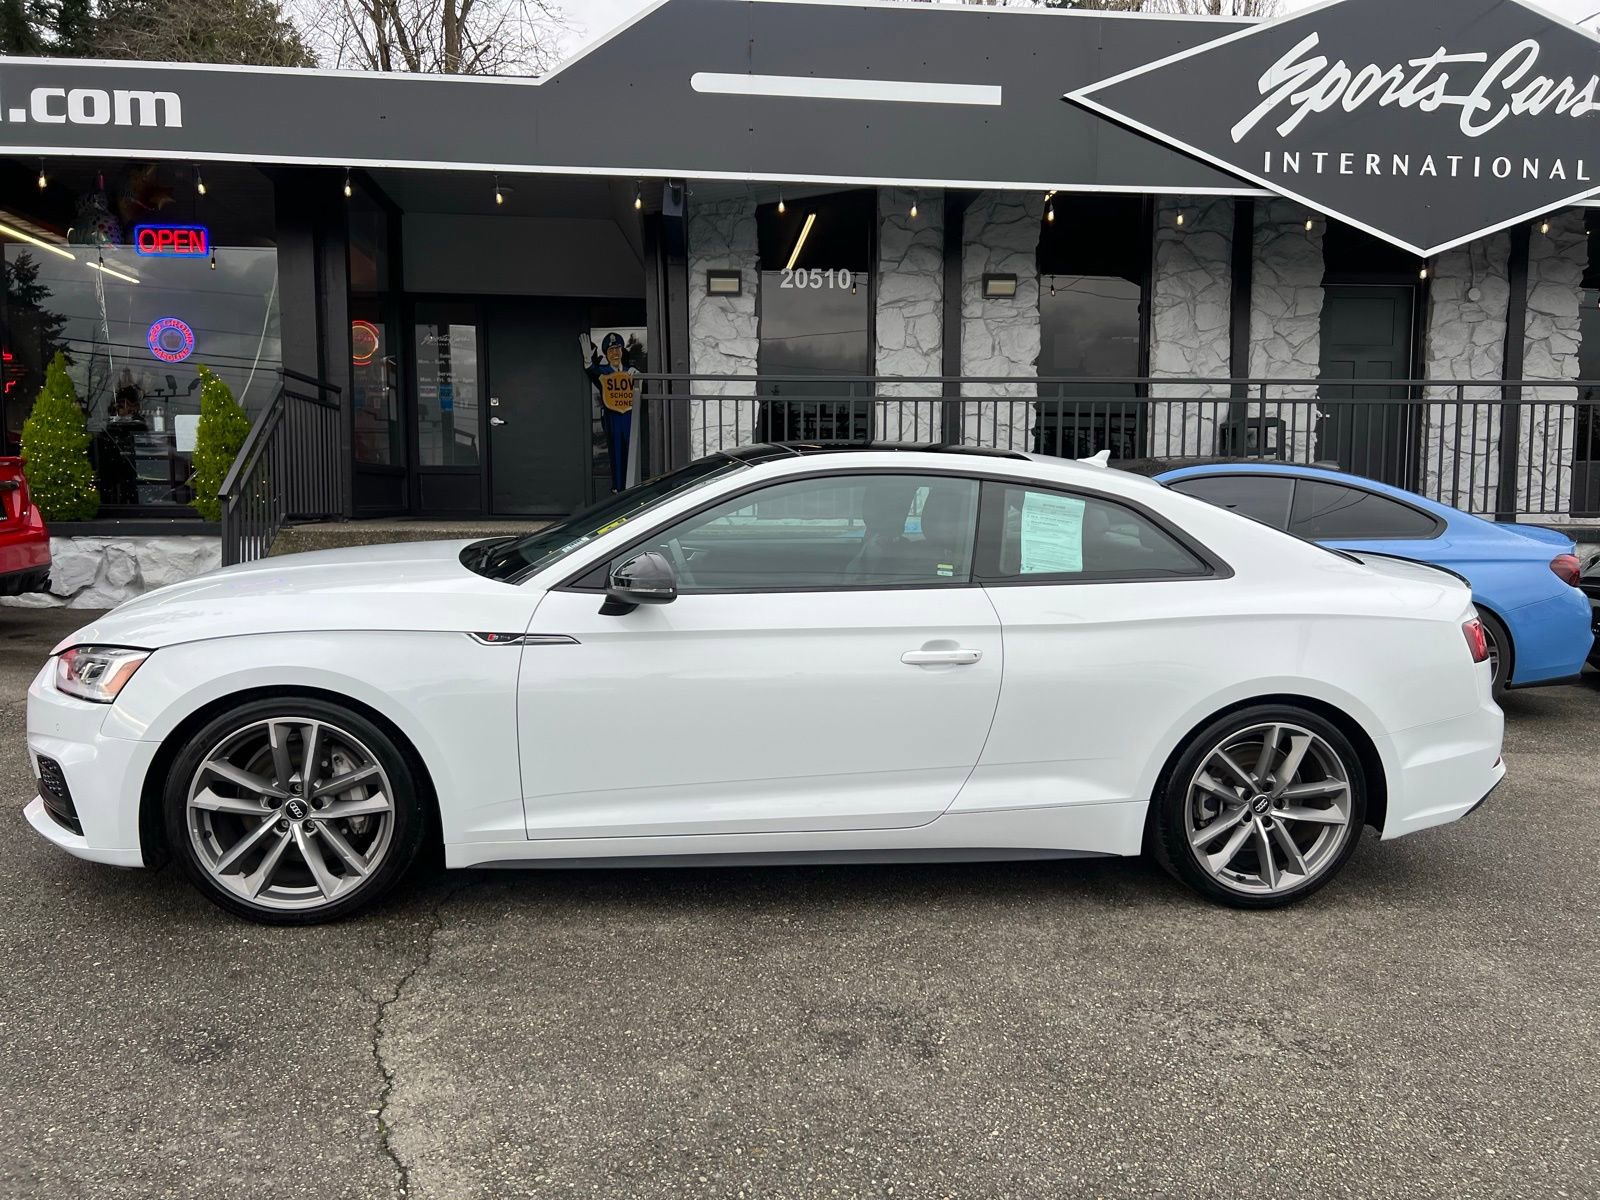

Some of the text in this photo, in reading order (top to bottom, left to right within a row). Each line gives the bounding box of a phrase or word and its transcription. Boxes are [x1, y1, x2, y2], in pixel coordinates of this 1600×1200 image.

[1231, 32, 1600, 142] Sports Cars
[0, 87, 182, 128] .com
[1263, 151, 1591, 181] INTERNATIONAL
[138, 229, 207, 254] OPEN
[780, 267, 851, 289] 20510
[150, 319, 193, 345] RED CROWN
[153, 346, 190, 362] GASOLINE
